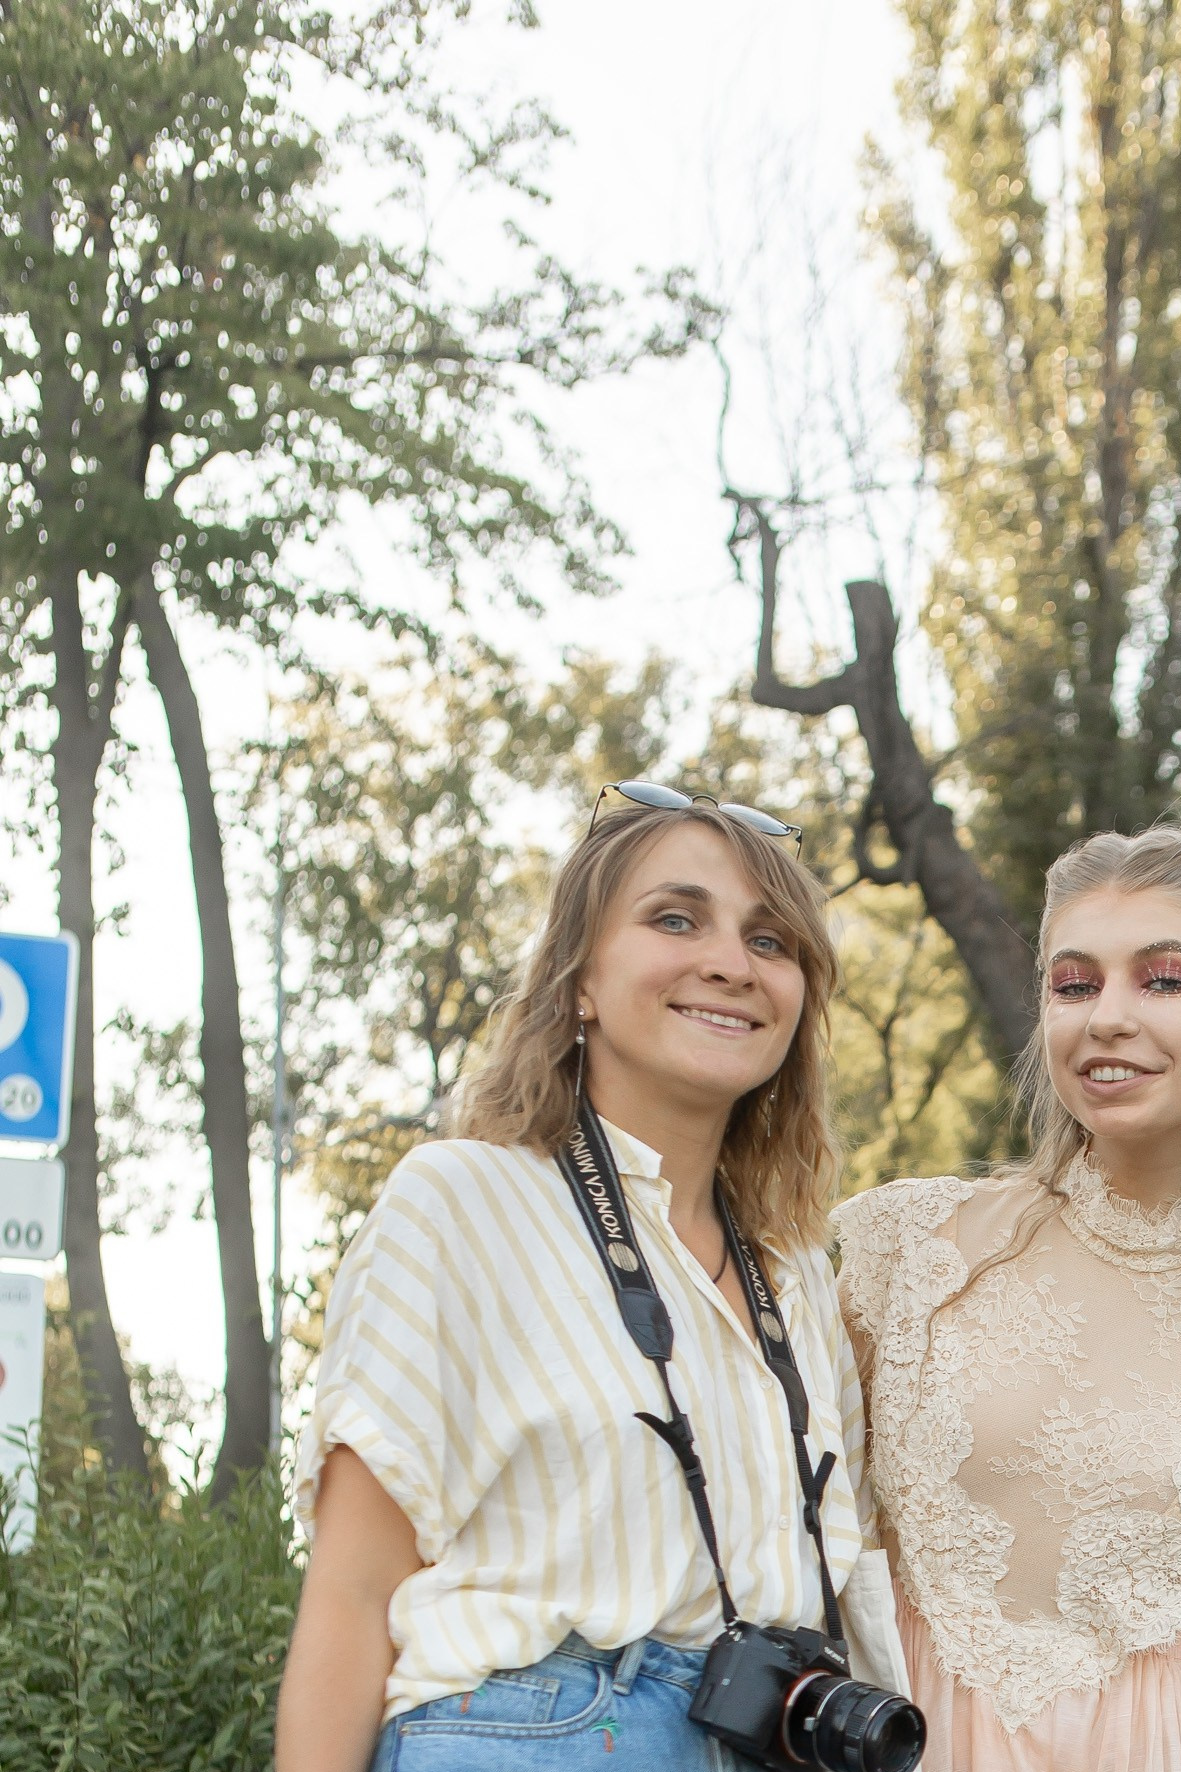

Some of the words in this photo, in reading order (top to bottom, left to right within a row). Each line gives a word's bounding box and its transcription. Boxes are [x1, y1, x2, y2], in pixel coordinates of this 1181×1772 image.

[568, 1122, 599, 1173] MINOL
[584, 1175, 624, 1239] KONICA
[741, 1245, 771, 1309] KONICA
